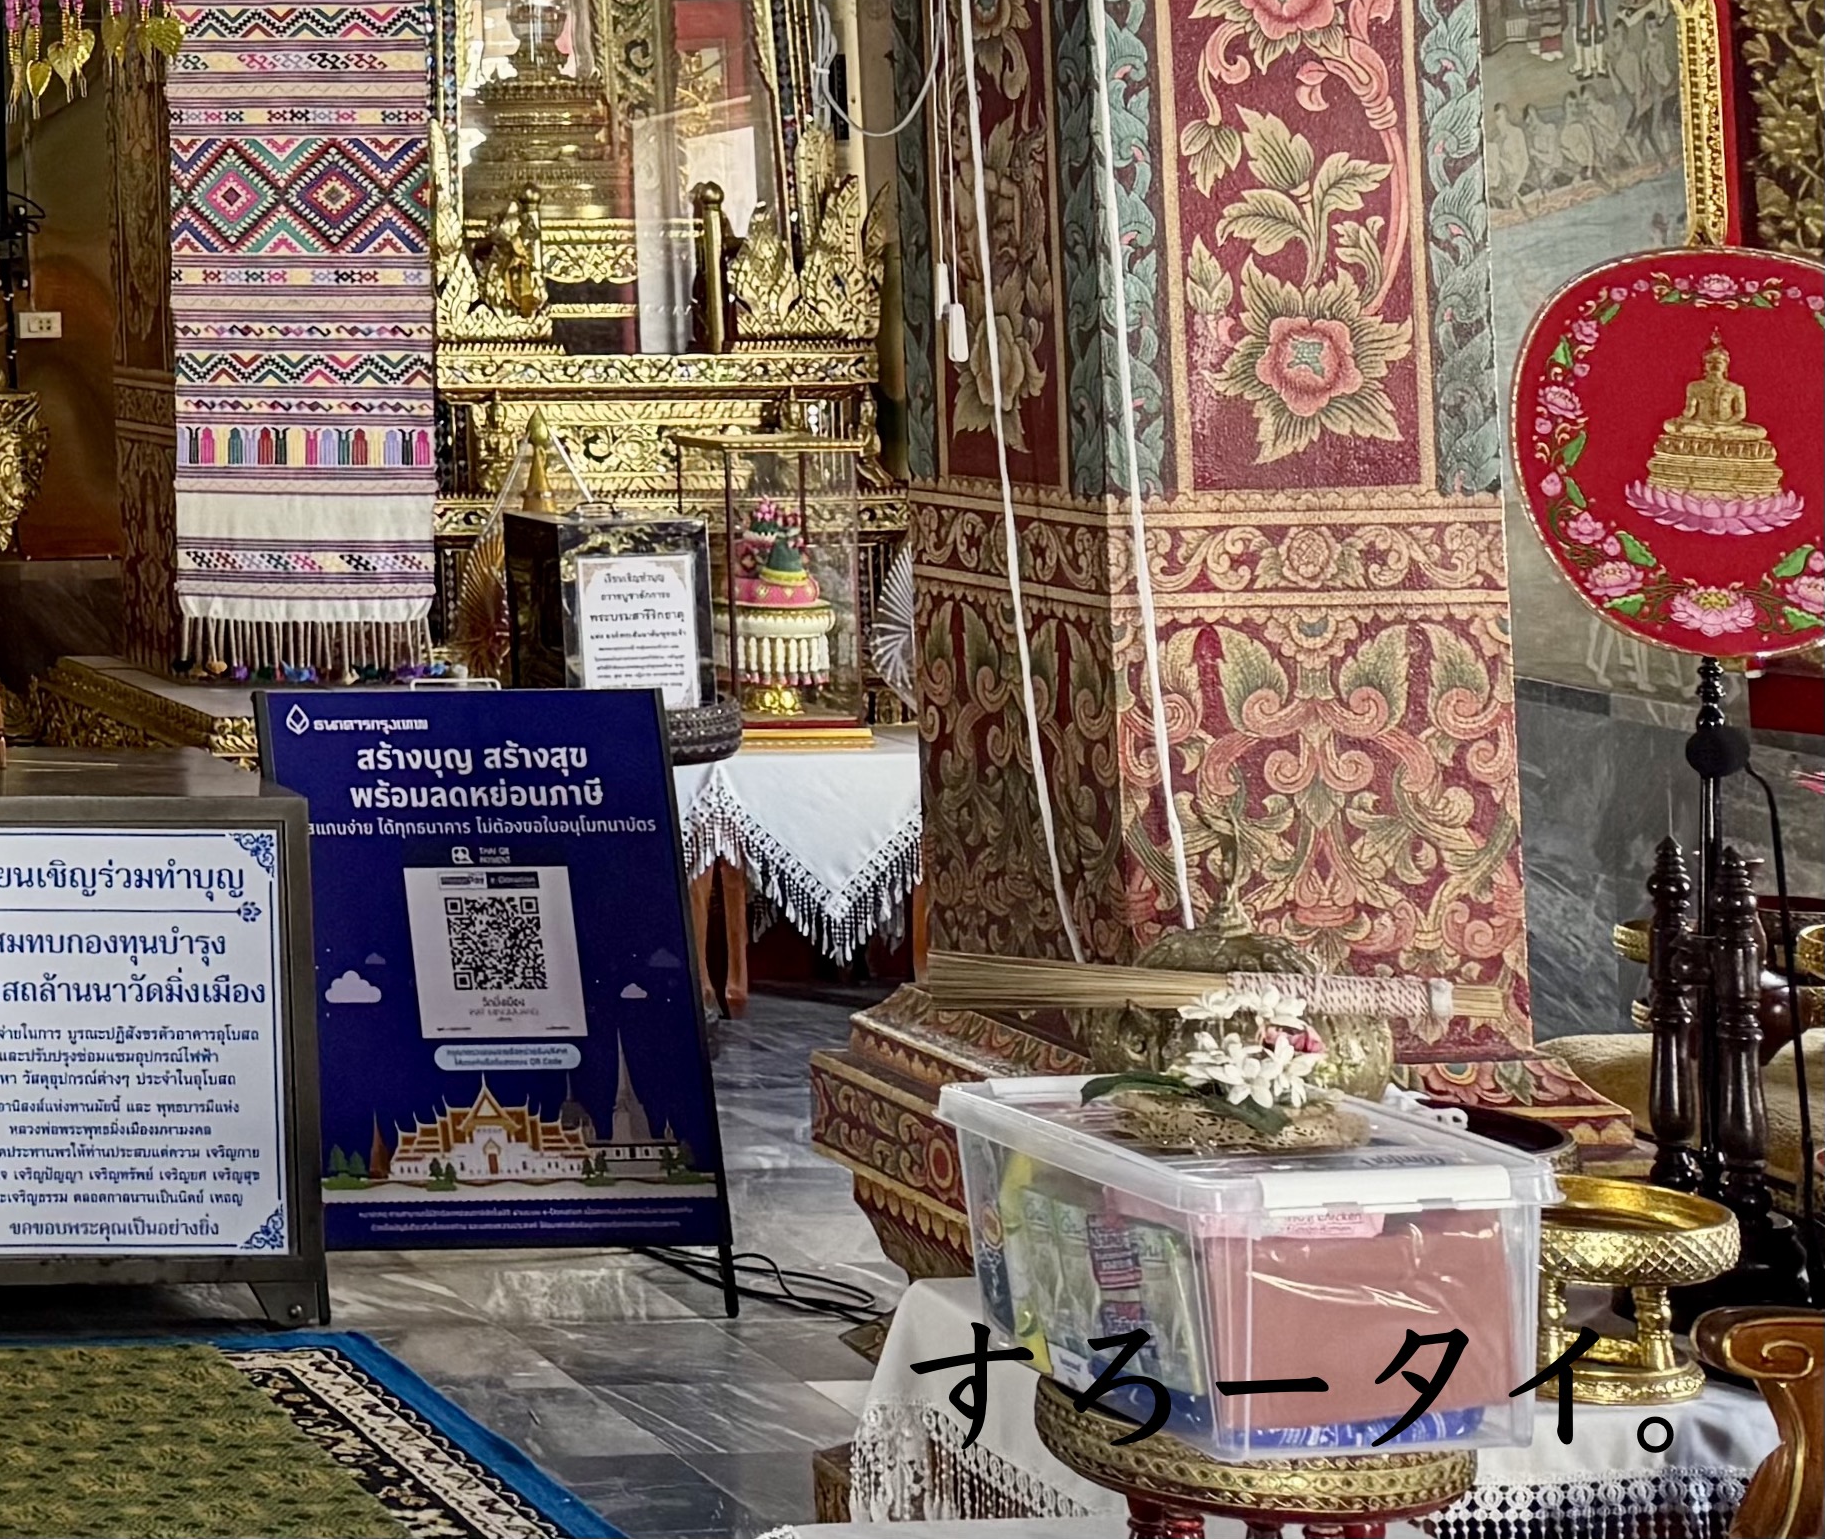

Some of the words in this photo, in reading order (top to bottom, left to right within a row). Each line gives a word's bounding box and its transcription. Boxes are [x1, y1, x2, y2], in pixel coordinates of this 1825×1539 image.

[312, 718, 429, 736] ธนาคารกรุงเทพ
[356, 740, 474, 779] สร้างบุญ
[483, 739, 588, 778] สร้างสุข
[349, 776, 604, 809] พร้อมลดหย่อนภาษี
[376, 816, 472, 840] ได้ทุกธนาคาร
[475, 814, 657, 837] ไม่ต้องขอใบอนุโมทนาบัตร
